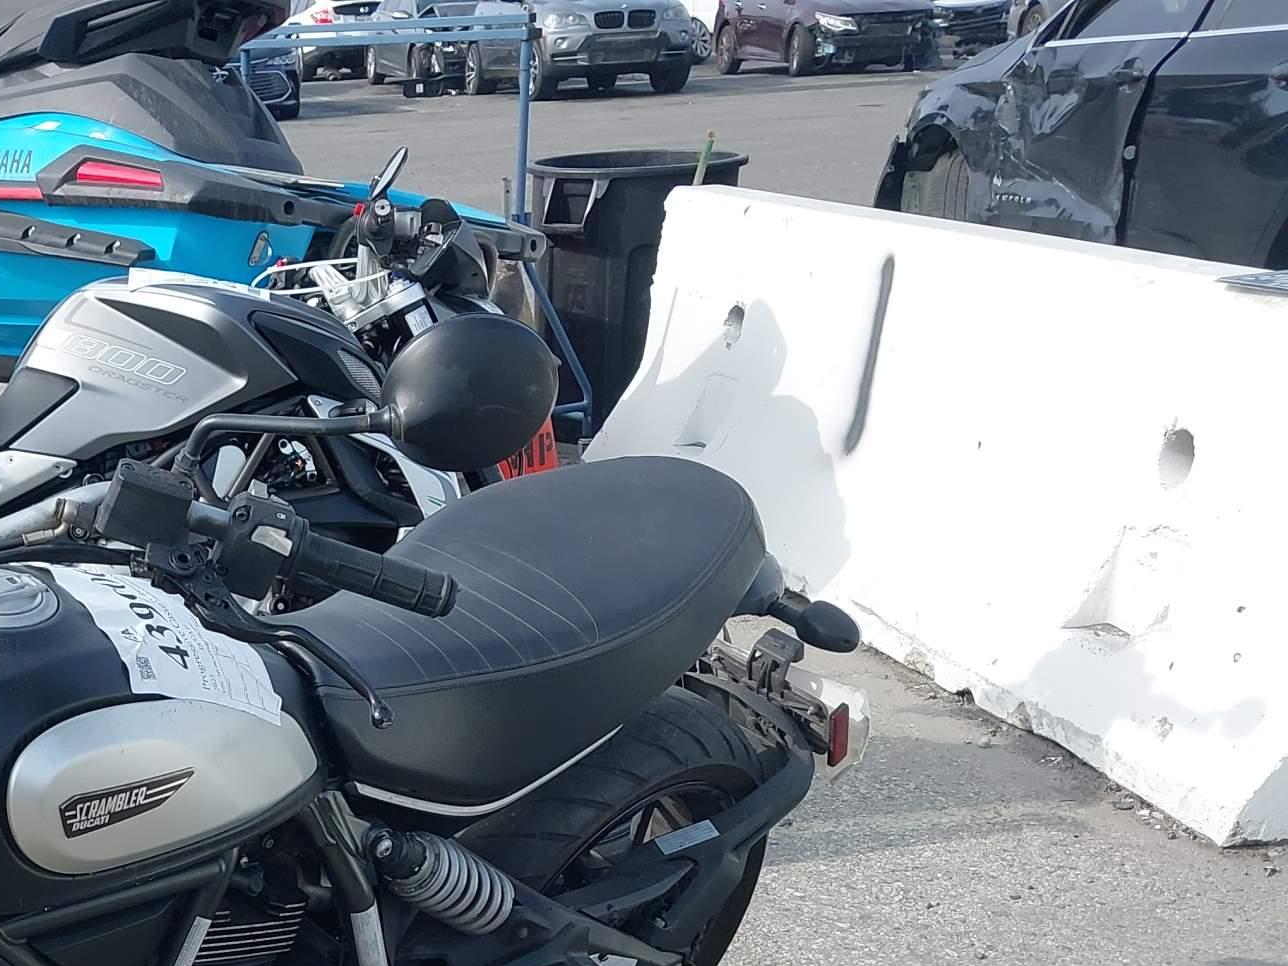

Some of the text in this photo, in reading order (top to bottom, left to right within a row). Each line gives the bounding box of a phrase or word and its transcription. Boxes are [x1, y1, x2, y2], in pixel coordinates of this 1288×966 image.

[63, 334, 187, 385] 800
[88, 366, 191, 403] DRAGSTER
[73, 786, 147, 822] SCRAMBLER
[72, 814, 110, 832] DUCATI
